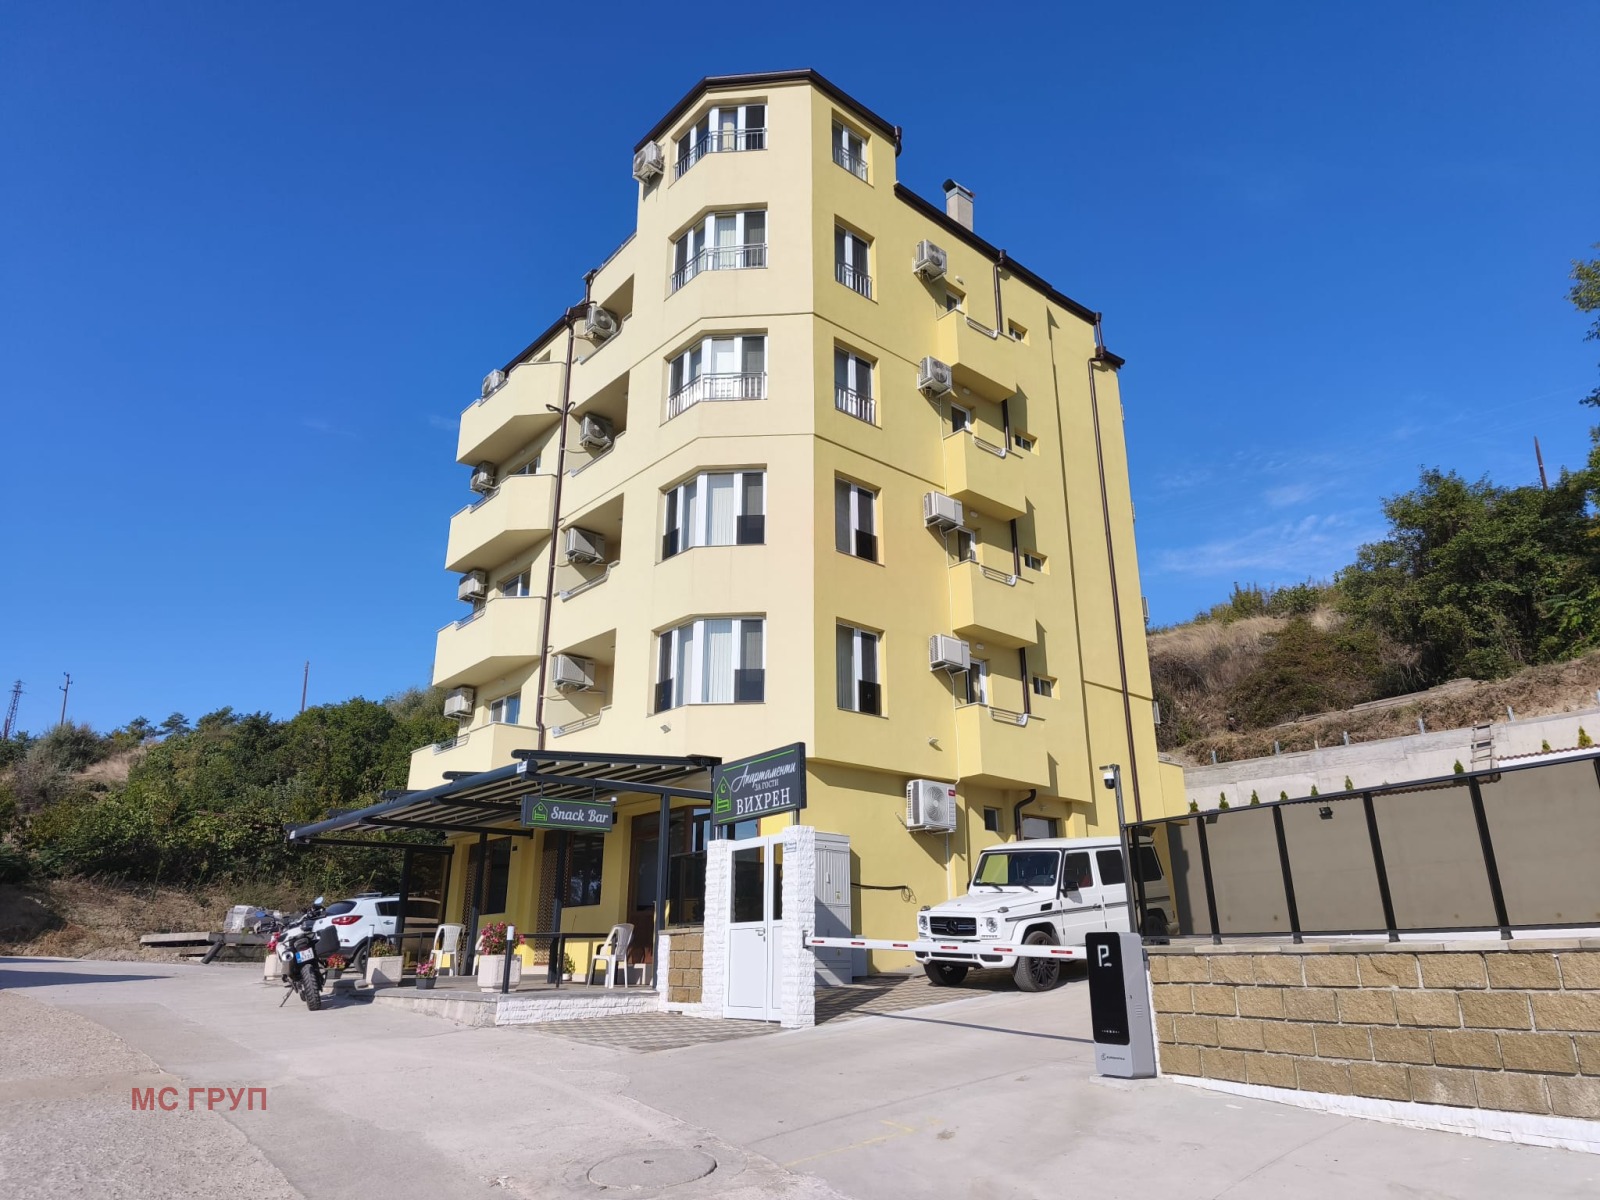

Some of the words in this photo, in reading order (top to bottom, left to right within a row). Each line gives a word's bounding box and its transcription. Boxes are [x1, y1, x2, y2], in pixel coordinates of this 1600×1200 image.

[731, 762, 796, 793] Апартаменти
[754, 782, 762, 791] ЗА
[762, 778, 779, 790] ГОСТИ
[736, 787, 791, 815] ВИХРЕН
[550, 806, 585, 822] Snack
[588, 809, 609, 823] Bar
